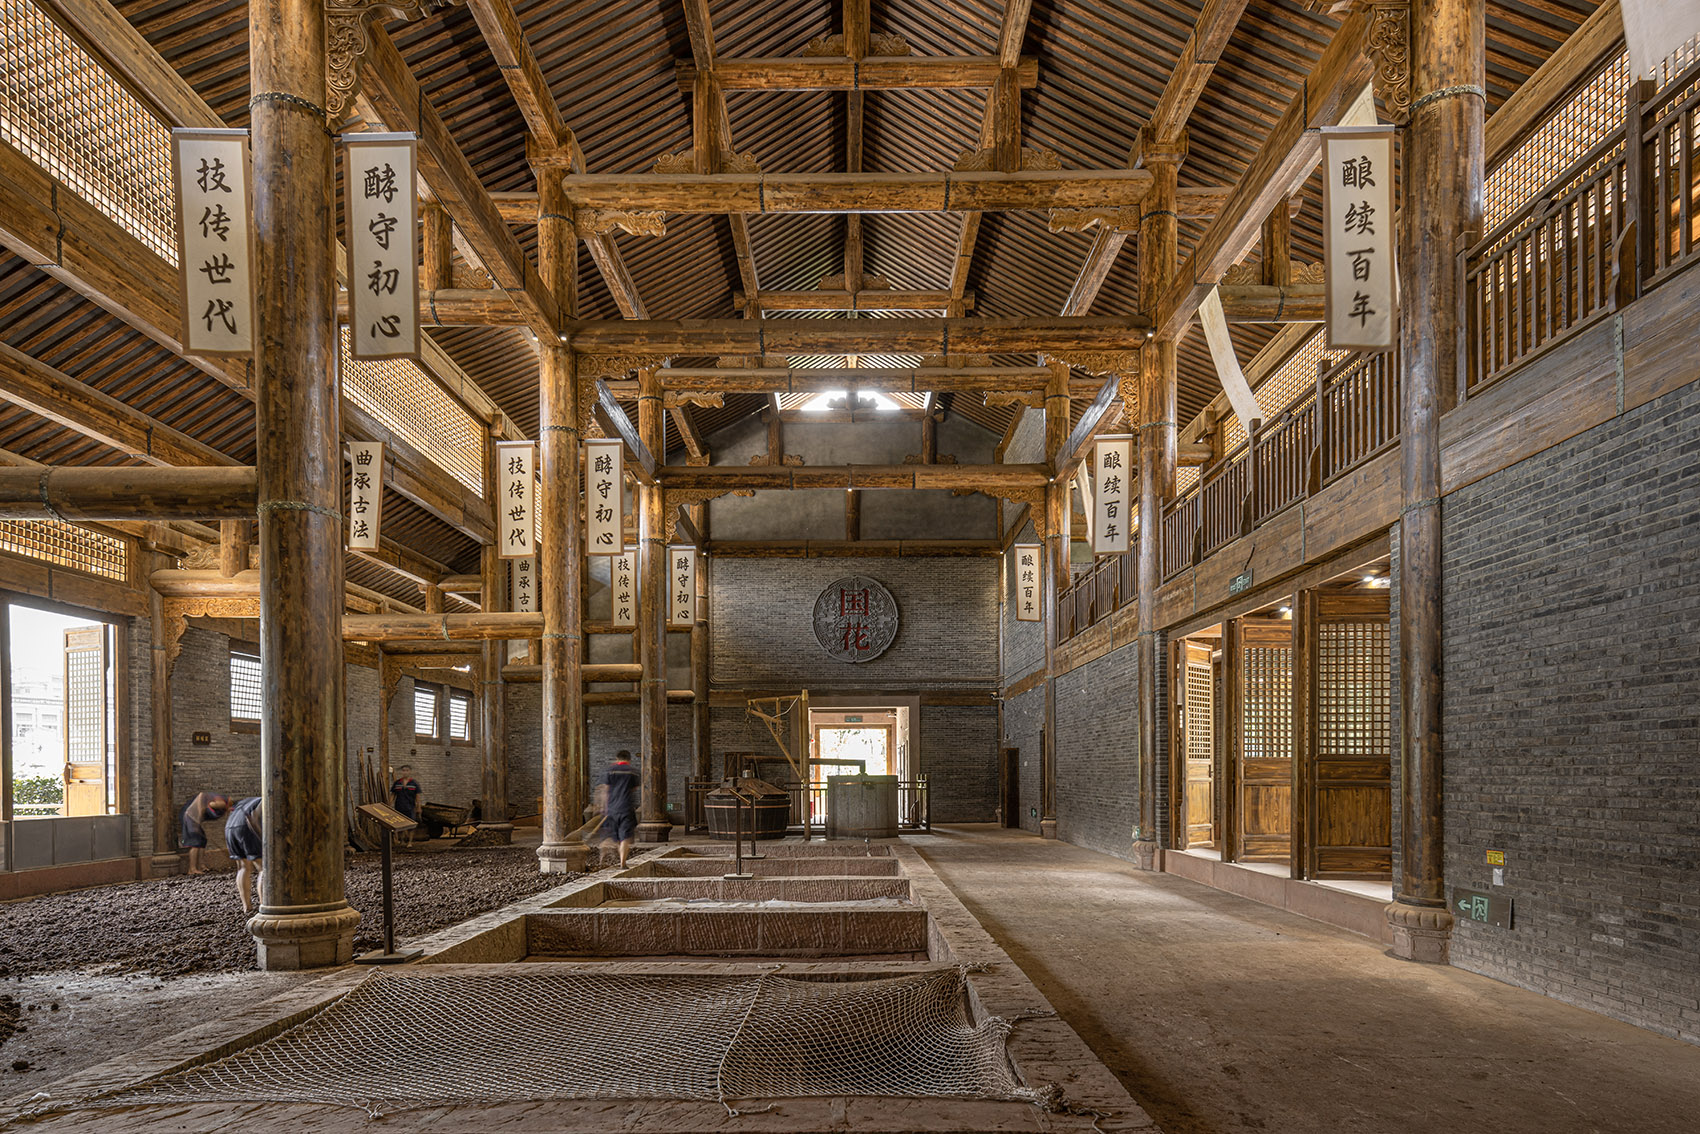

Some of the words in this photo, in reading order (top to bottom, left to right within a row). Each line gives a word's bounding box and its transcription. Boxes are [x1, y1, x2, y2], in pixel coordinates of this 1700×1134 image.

[196, 157, 238, 335] 技传世代
[363, 162, 401, 339] 酵守初心
[1341, 155, 1377, 329] 酿续百年
[353, 449, 373, 539] 曲承古法
[507, 456, 527, 547] 技传世代
[594, 454, 614, 546] 酵守初心
[1103, 450, 1122, 543] 酿续百年
[518, 559, 531, 612] 曲承古
[618, 558, 631, 621] 技传世代
[676, 556, 690, 620] 酵守初心
[840, 588, 870, 651] 国花
[1021, 554, 1035, 615] 酿续百年
